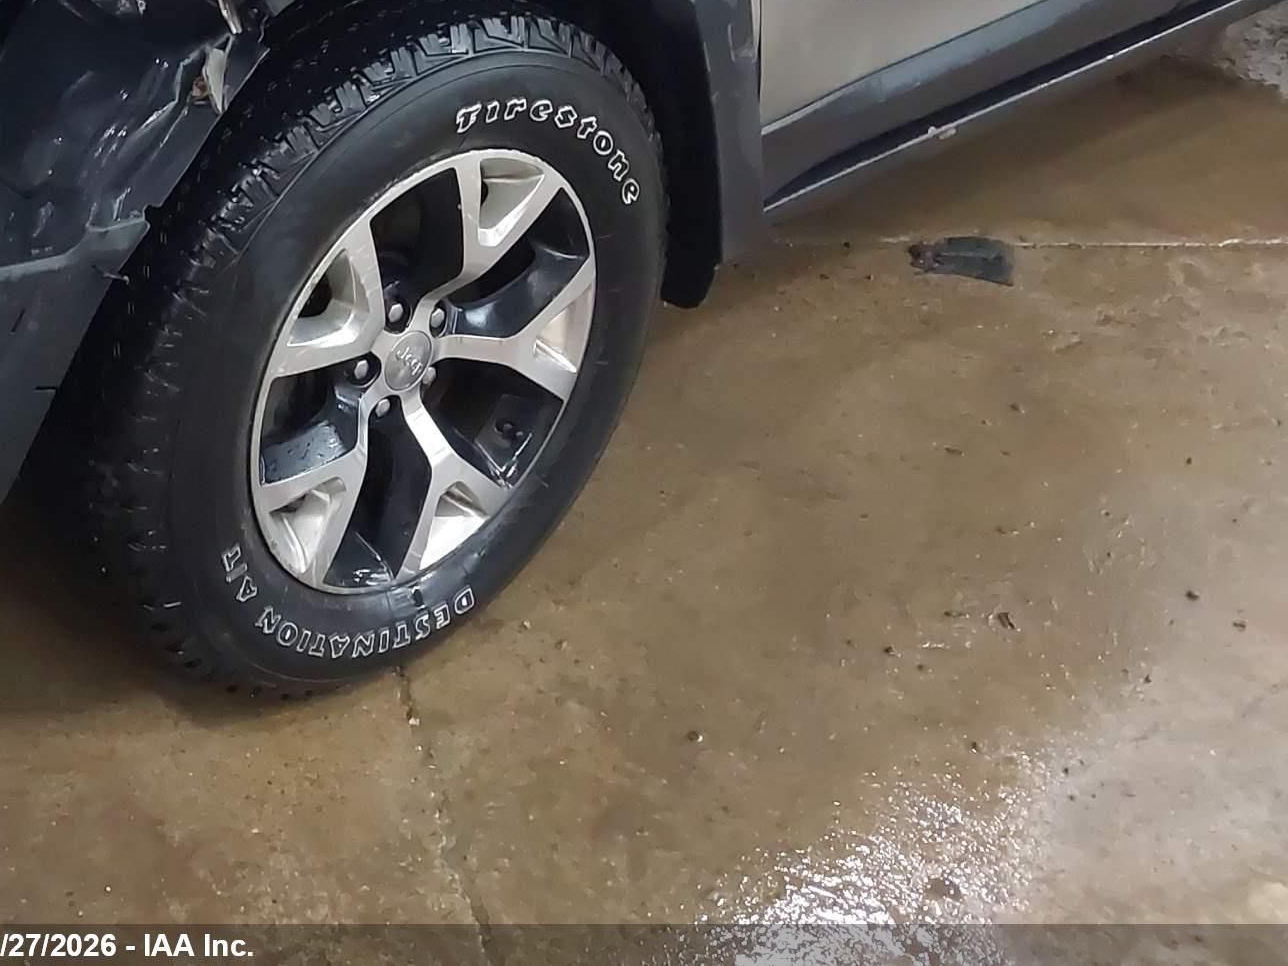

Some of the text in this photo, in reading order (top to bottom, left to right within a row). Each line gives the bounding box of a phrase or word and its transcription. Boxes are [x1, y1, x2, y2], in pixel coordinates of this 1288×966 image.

[455, 97, 641, 205] Firestone
[396, 346, 423, 376] Jeep
[221, 544, 475, 659] DESTINATION A/T
